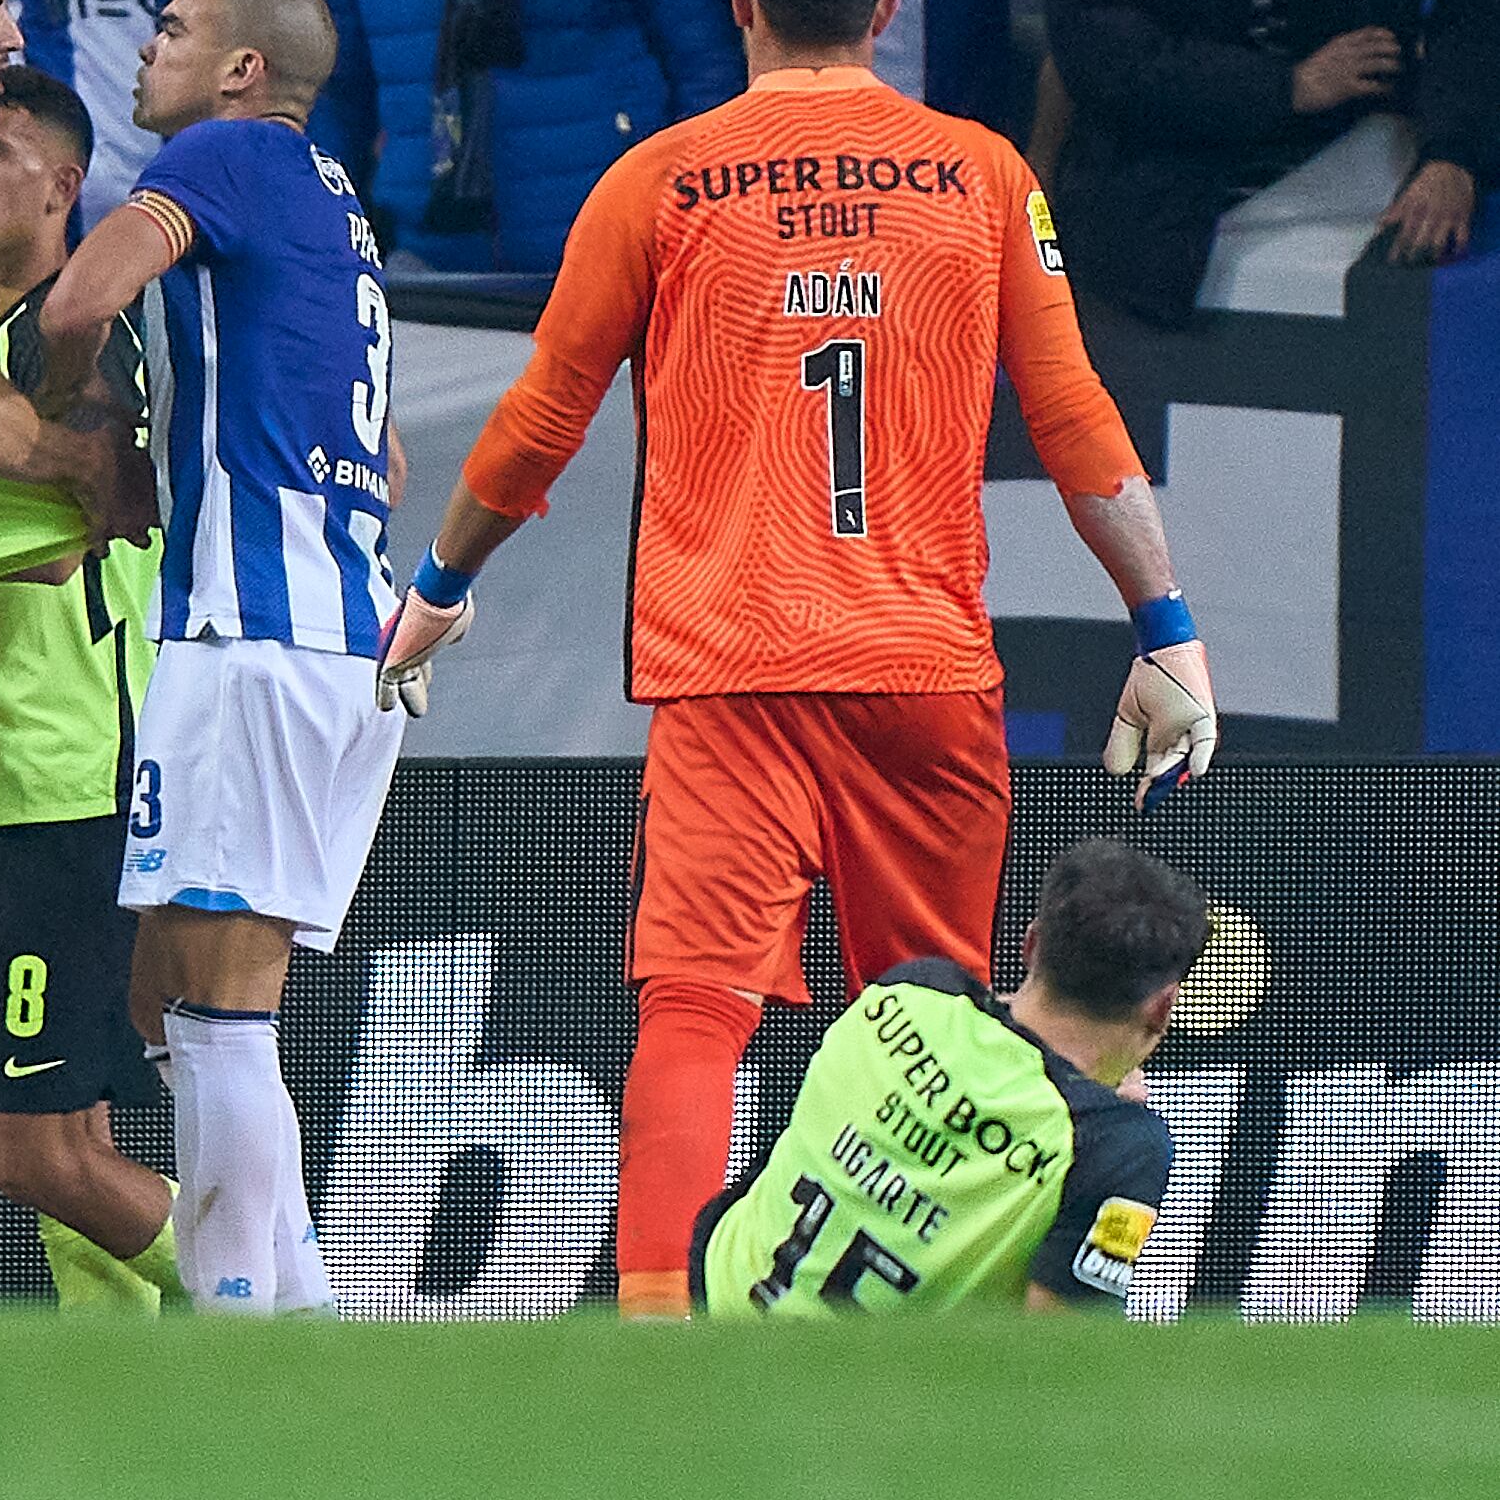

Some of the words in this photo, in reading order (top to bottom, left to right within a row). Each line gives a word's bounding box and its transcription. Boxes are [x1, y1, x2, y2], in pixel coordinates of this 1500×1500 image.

[673, 158, 822, 212] SUPER
[836, 154, 968, 197] BOCK
[776, 202, 881, 240] STOUT
[783, 256, 882, 317] ADÁN
[351, 272, 392, 456] 3
[800, 338, 868, 539] 1
[130, 759, 163, 839] 3
[4, 953, 49, 1039] 8
[315, 900, 1500, 1325] bin
[864, 994, 951, 1109] SUPER
[943, 1095, 1061, 1186] BOCK
[875, 1091, 969, 1180] STOUT
[831, 1123, 951, 1246] UGARTE
